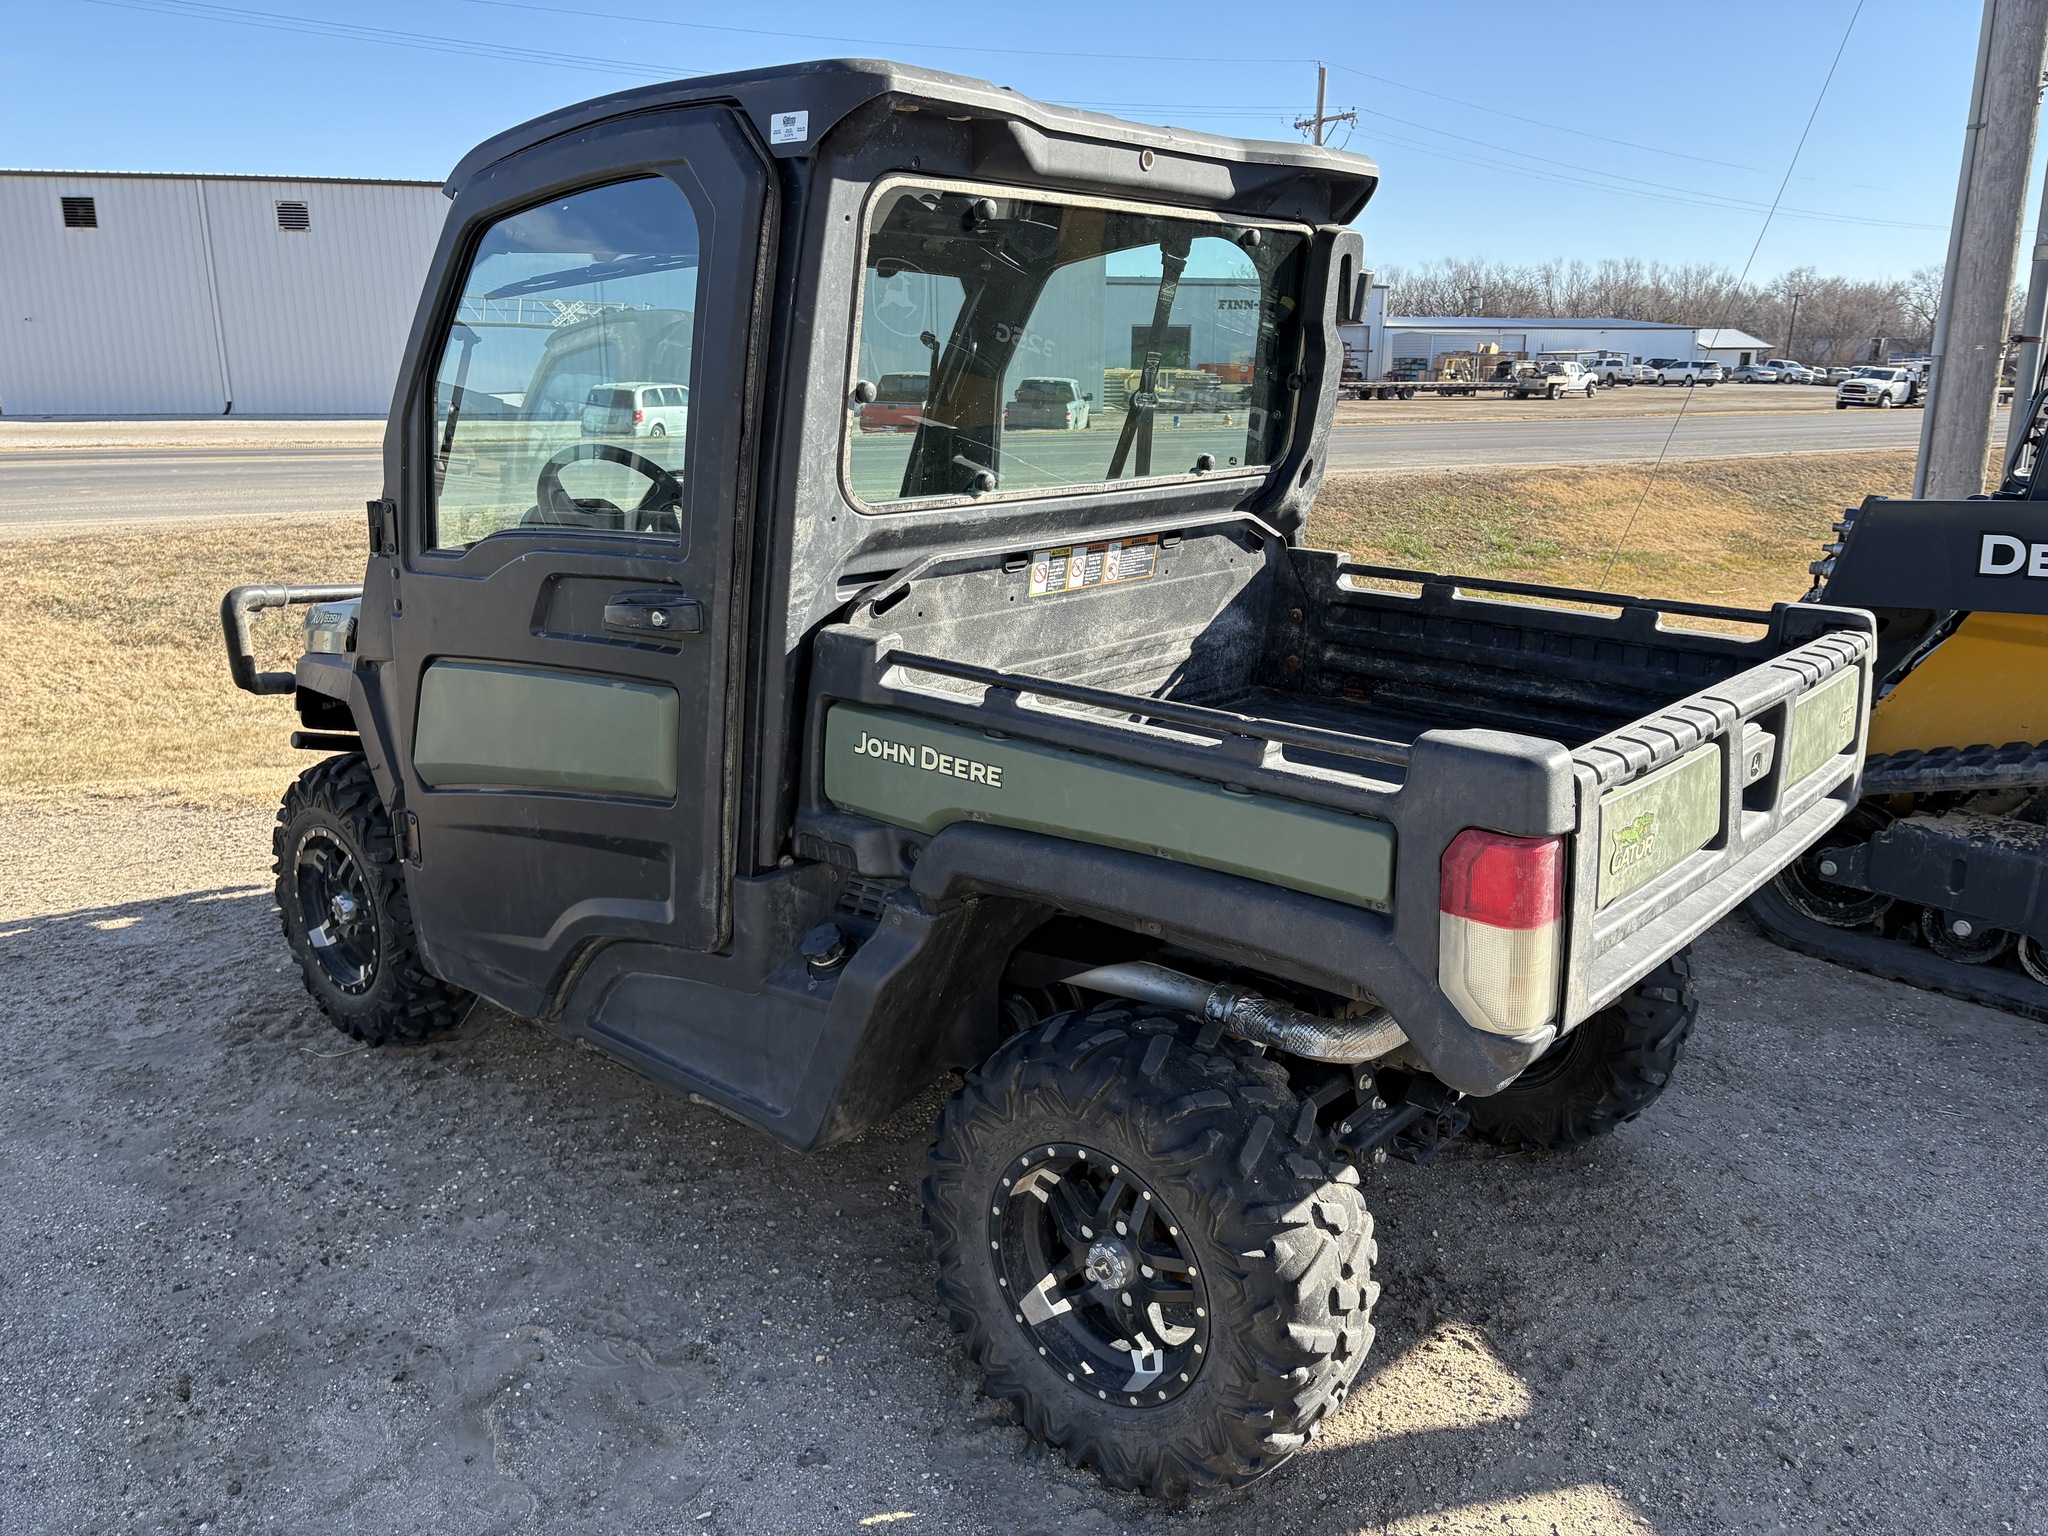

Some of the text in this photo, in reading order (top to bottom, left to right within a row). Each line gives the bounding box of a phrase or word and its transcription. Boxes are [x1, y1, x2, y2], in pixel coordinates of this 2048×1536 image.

[854, 731, 1002, 788] JOHN DEERE
[1609, 833, 1655, 875] GATOR
